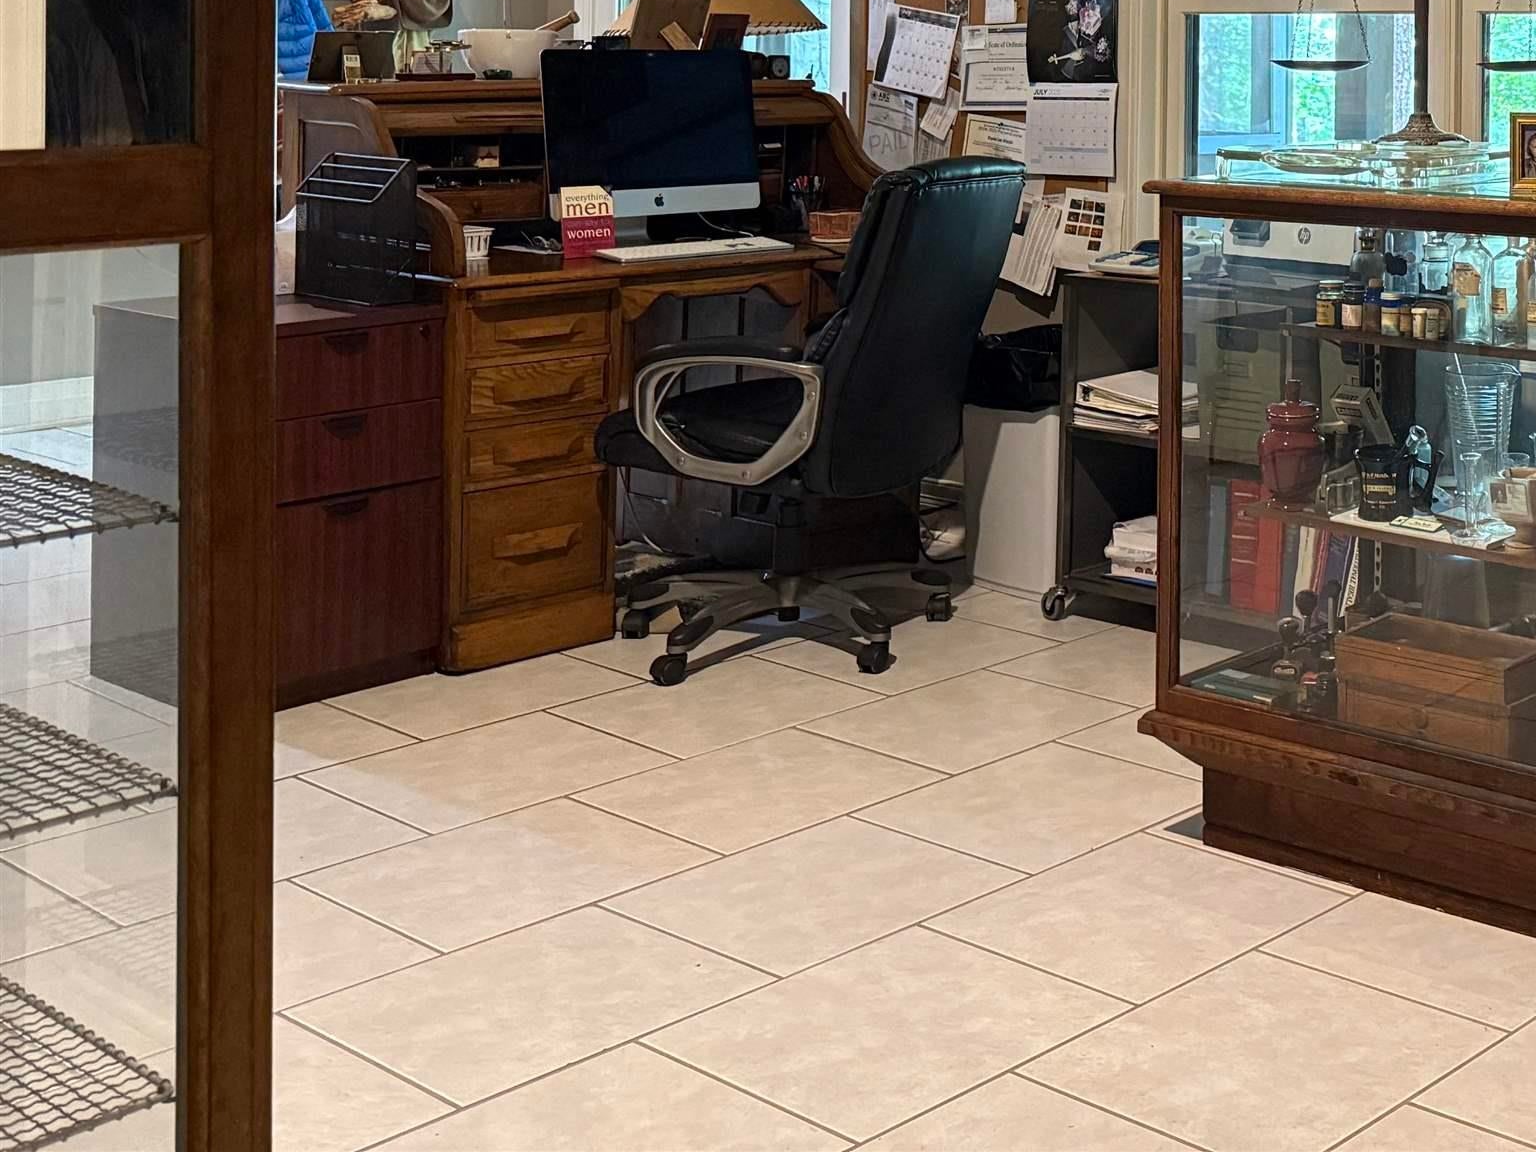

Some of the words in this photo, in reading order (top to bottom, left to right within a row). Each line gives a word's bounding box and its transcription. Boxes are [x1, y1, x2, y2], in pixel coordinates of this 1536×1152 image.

[869, 131, 909, 154] PAID
[566, 201, 609, 217] men
[566, 228, 611, 239] women
[1298, 228, 1311, 245] hp
